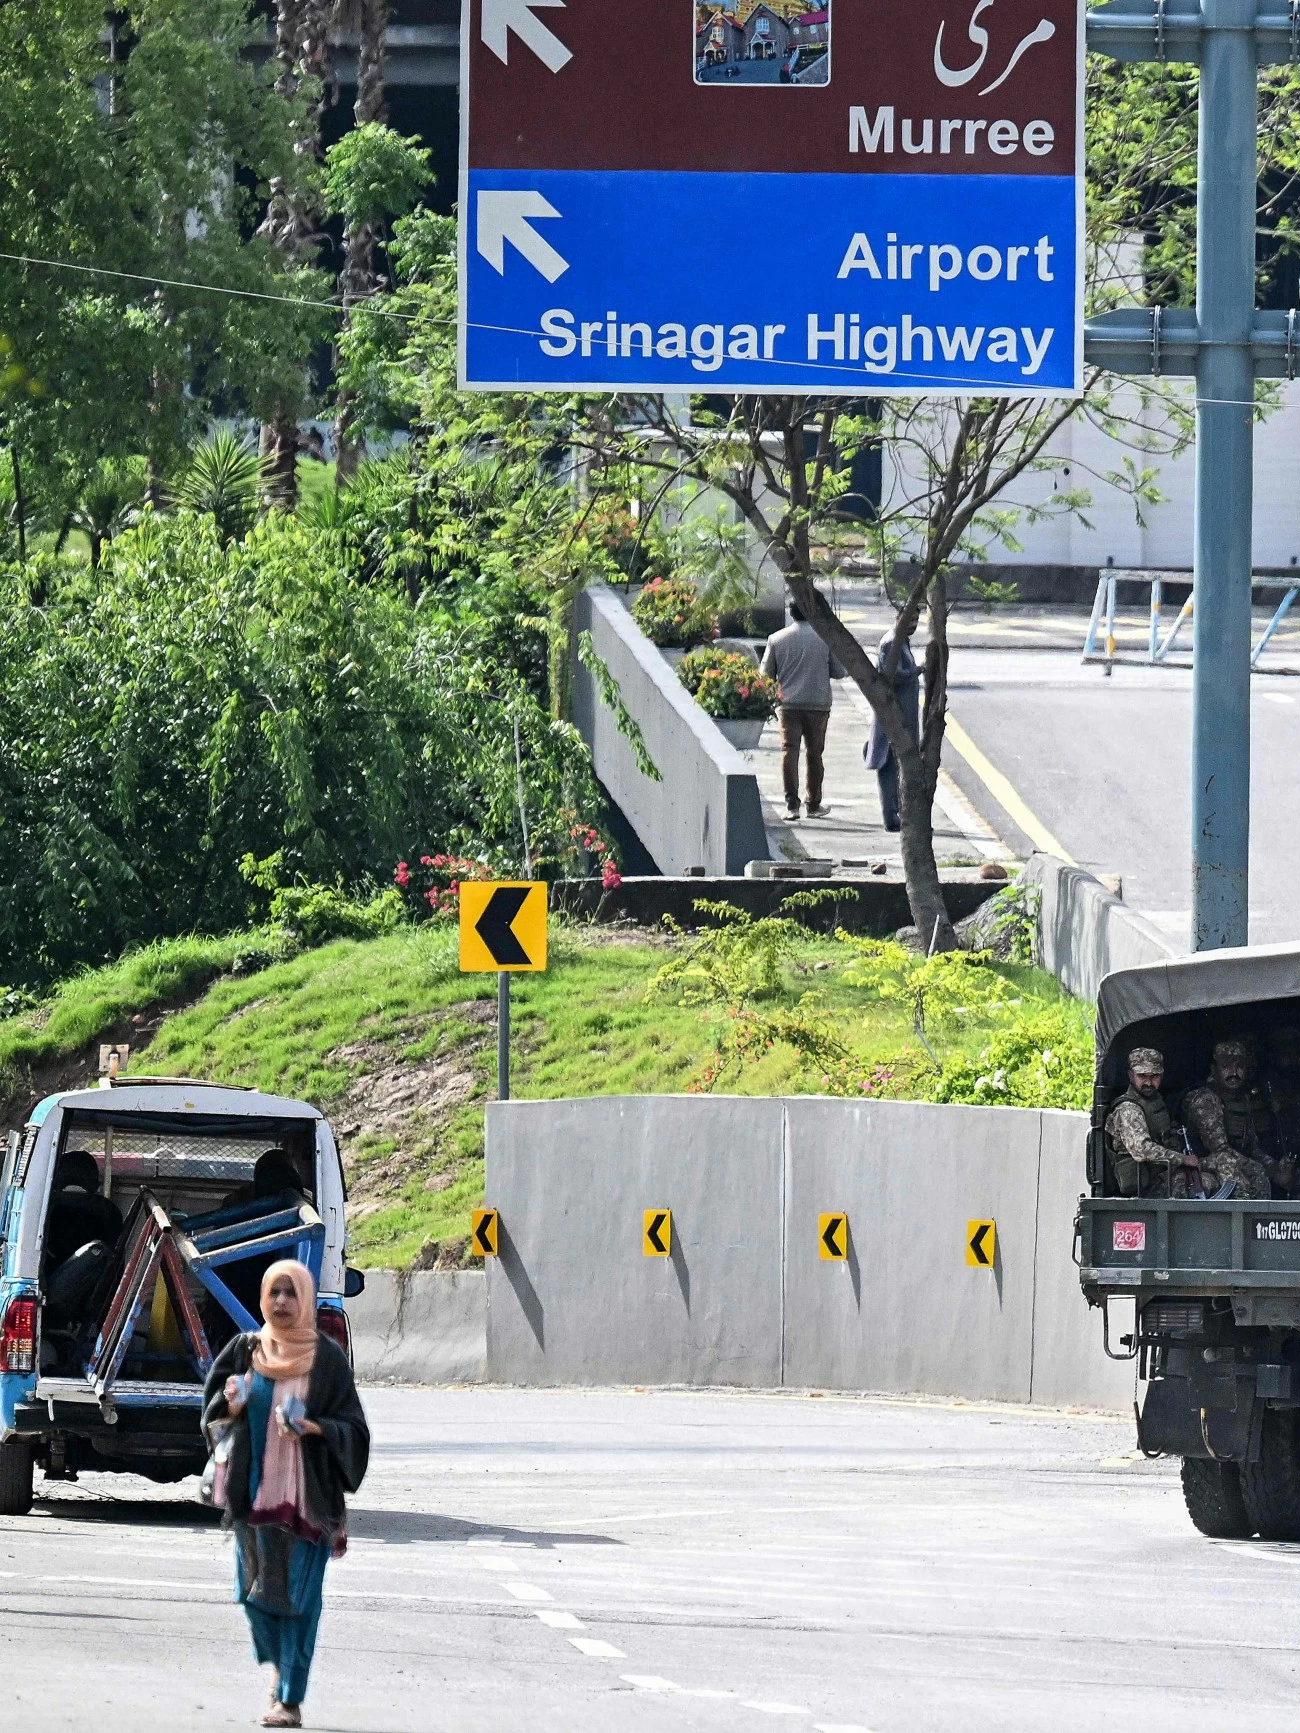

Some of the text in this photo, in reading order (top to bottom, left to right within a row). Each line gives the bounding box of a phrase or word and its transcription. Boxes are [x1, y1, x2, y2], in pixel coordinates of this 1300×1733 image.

[848, 105, 1055, 156] Murree
[836, 232, 1054, 292] Airport
[539, 308, 1055, 375] Srinagar Highway
